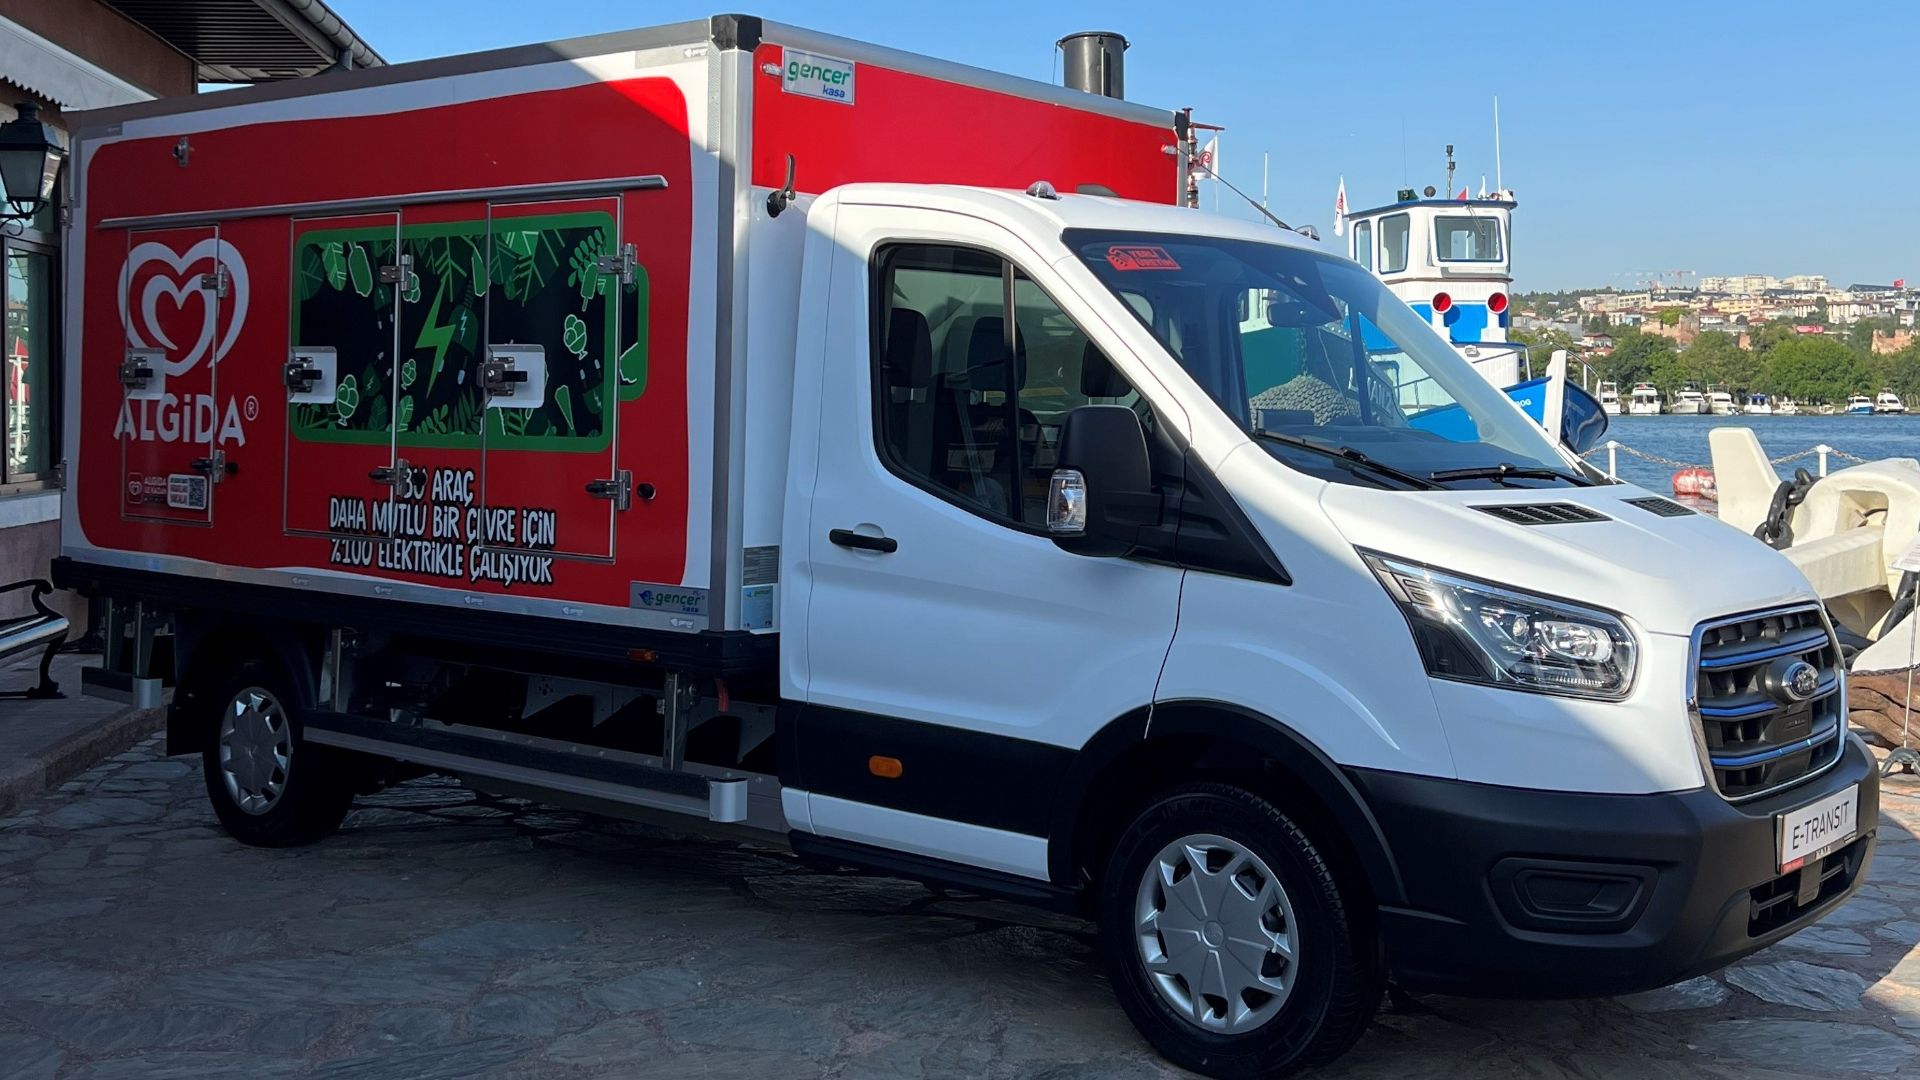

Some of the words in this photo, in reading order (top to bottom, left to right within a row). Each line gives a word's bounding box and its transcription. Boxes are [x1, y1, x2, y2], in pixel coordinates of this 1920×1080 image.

[787, 61, 851, 85] gencer
[823, 85, 845, 98] kasa
[432, 469, 474, 507] ARAÇ
[330, 498, 366, 531] DAHA
[372, 501, 427, 535] MUTLU
[330, 539, 373, 566] %100
[655, 591, 701, 606] gencer
[1792, 799, 1850, 850] E-TRANSIT
